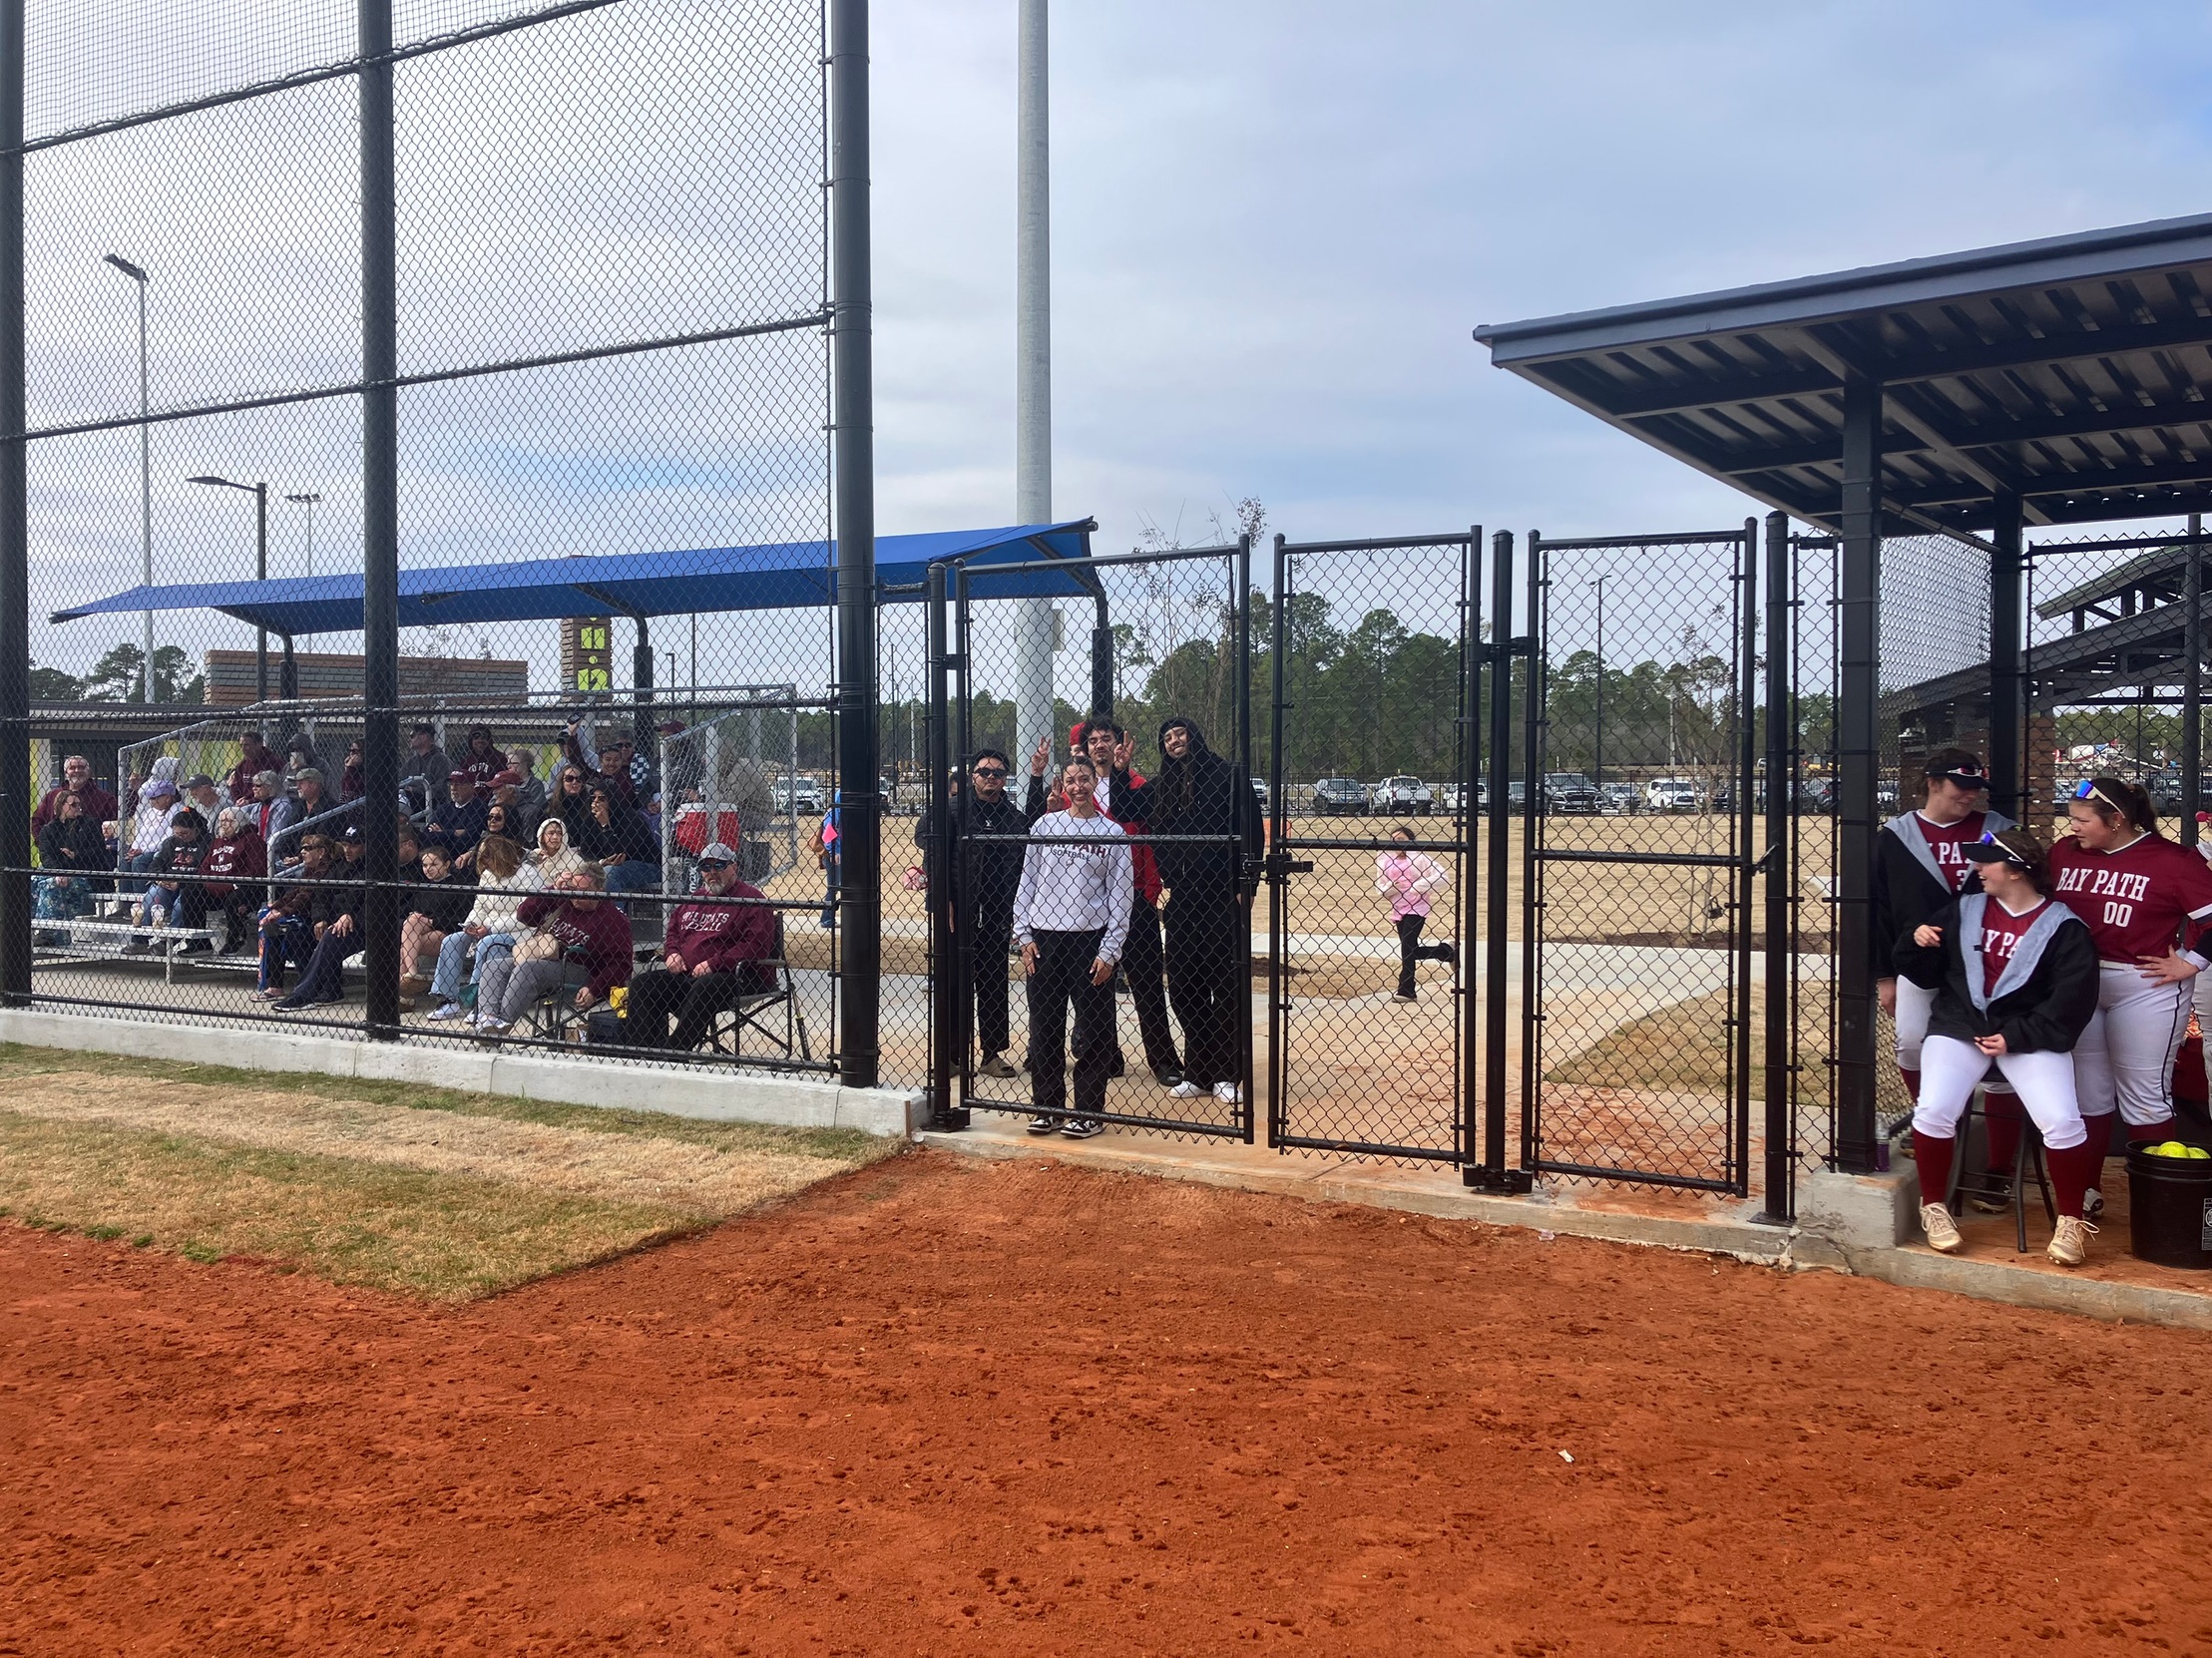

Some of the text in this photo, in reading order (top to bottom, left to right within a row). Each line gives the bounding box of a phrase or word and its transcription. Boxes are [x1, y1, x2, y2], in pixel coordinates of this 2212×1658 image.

[578, 667, 609, 691] 12
[2055, 867, 2150, 902] BAY PATH
[2103, 901, 2133, 928] 00
